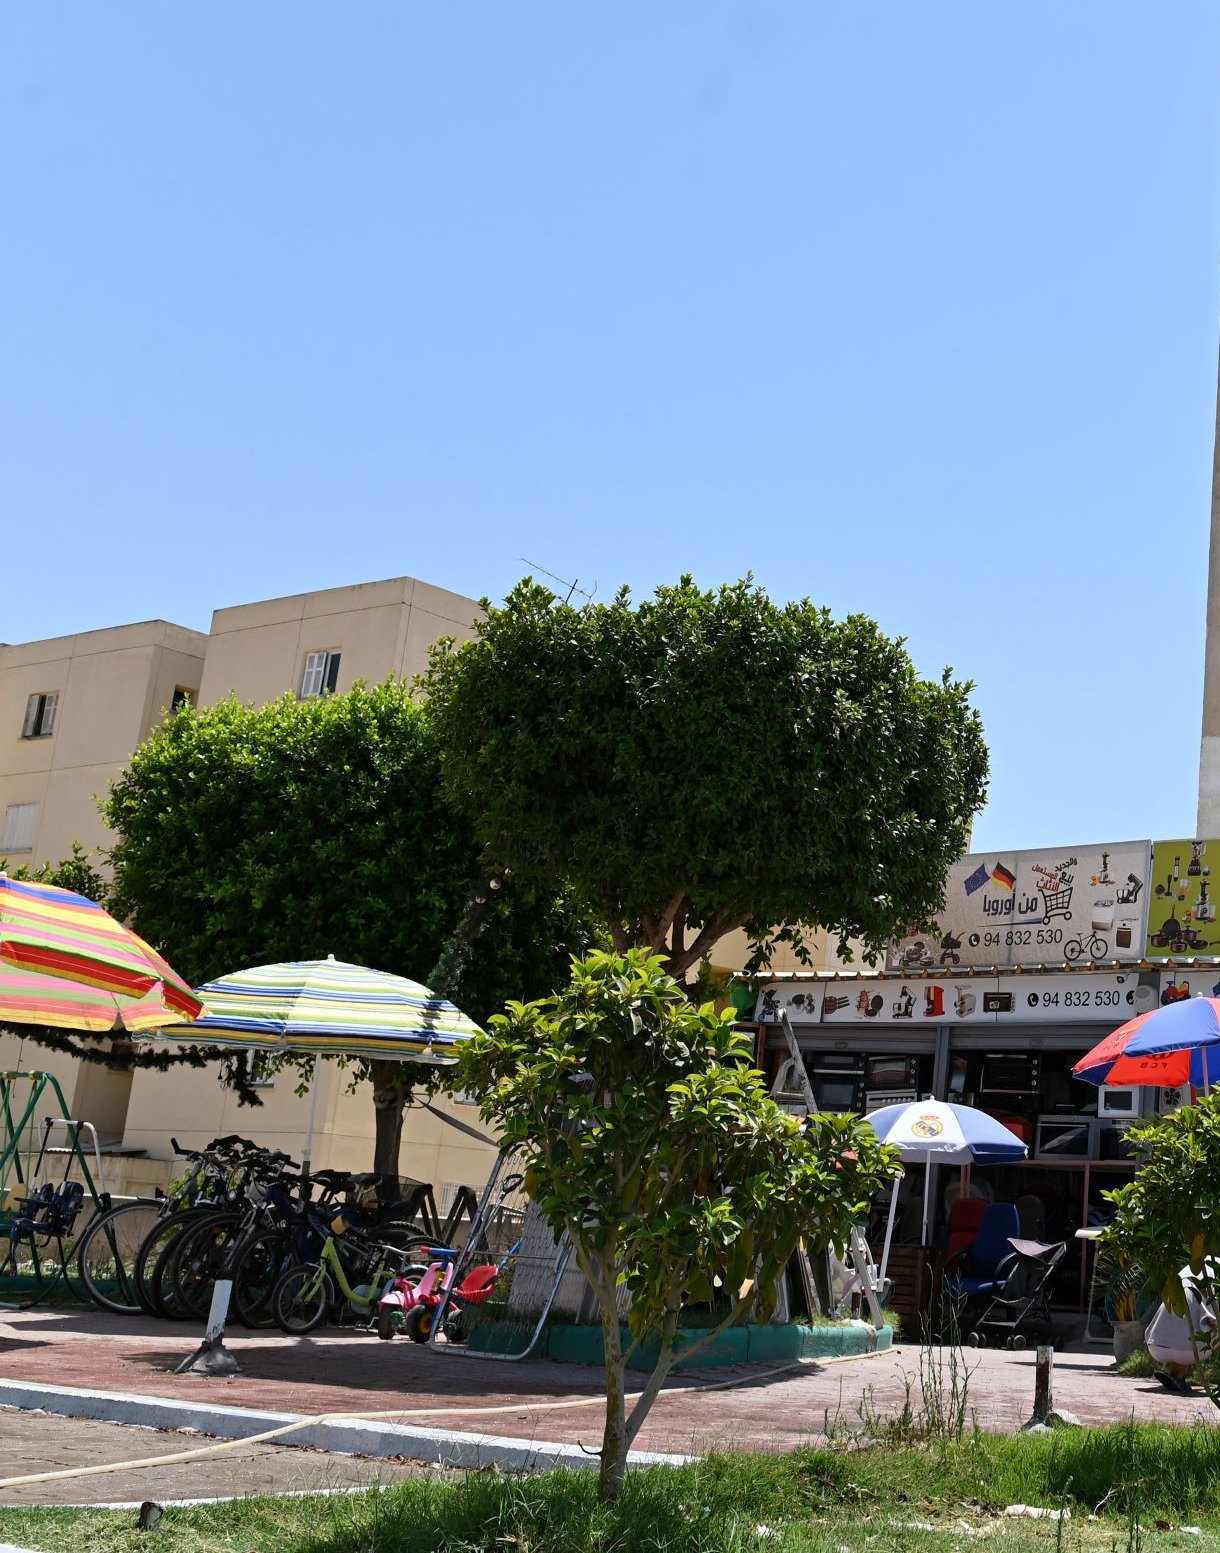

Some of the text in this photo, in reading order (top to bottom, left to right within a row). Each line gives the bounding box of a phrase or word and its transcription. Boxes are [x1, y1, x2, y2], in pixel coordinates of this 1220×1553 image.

[1018, 893, 1038, 915] من
[983, 928, 1063, 947] 94 832 530
[1042, 990, 1120, 1007] 94 832 530
